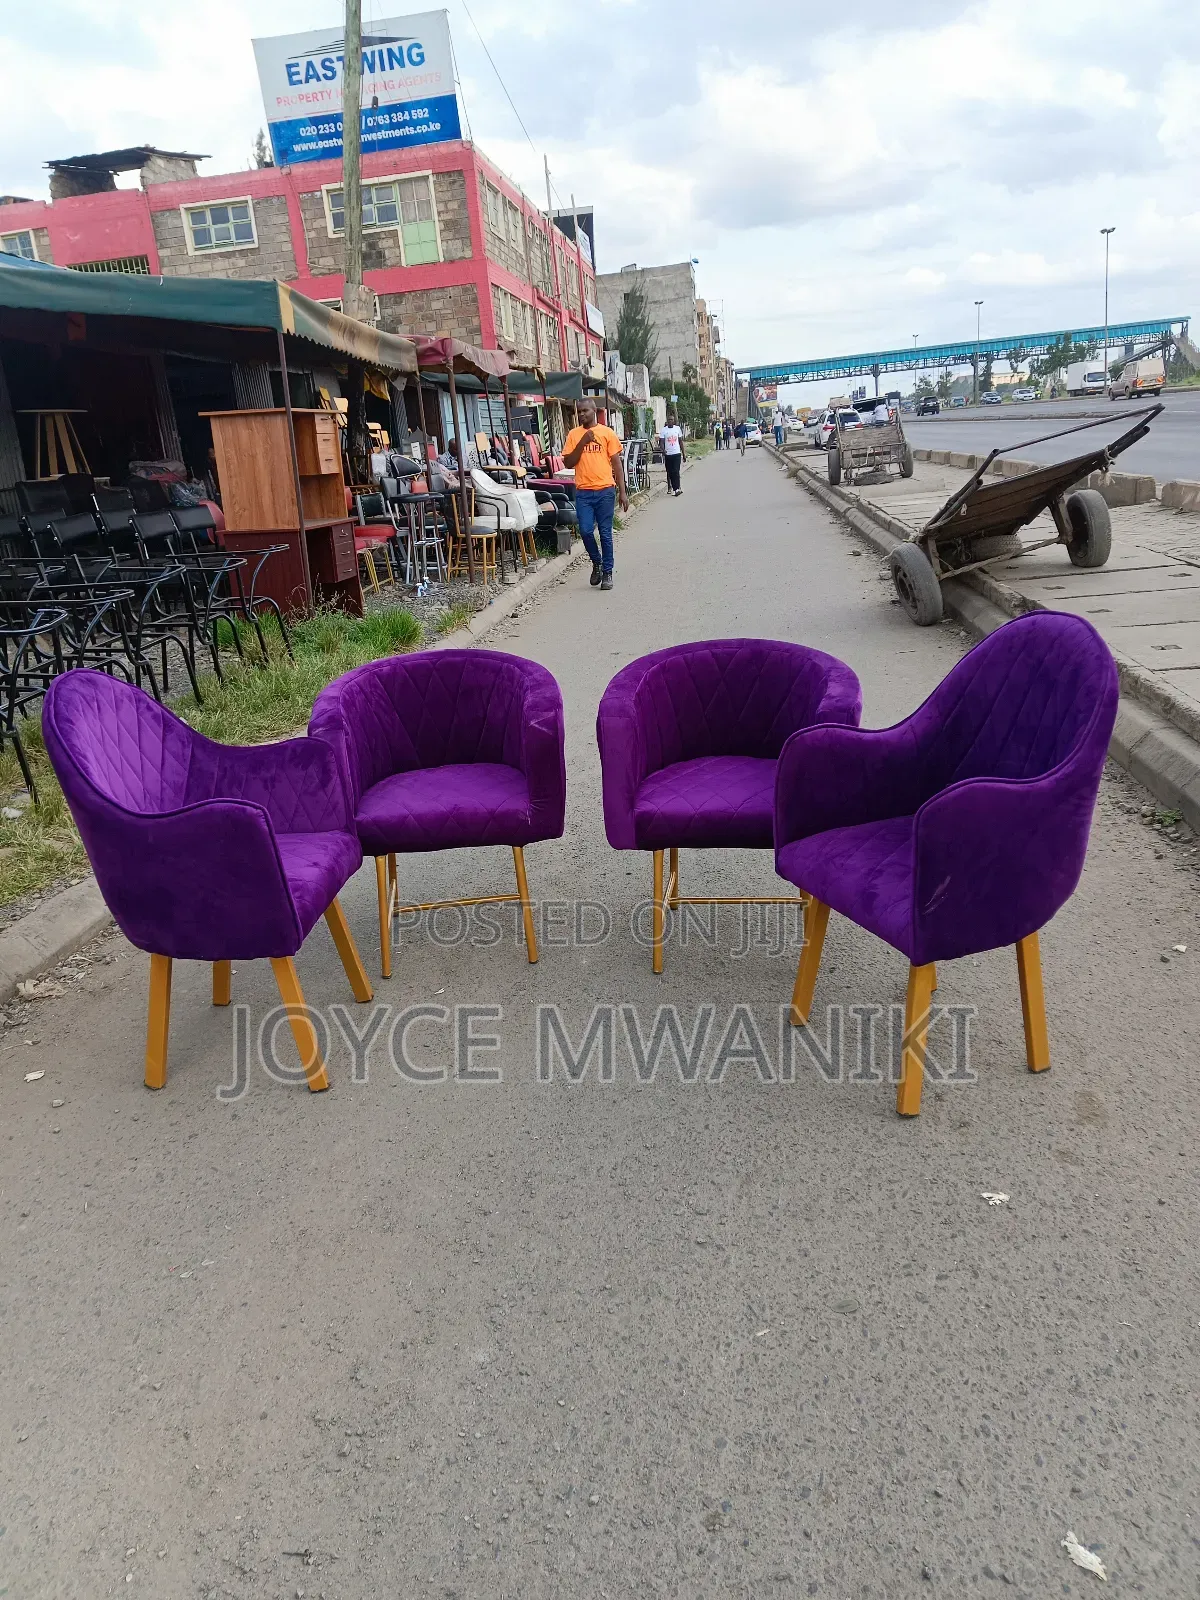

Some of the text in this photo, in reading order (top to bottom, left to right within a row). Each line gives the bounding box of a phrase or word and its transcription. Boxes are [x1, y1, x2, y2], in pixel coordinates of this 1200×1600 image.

[276, 88, 332, 107] PROPERTY
[398, 71, 441, 89] AGENTS
[299, 126, 317, 137] 020
[318, 123, 336, 134] 233
[367, 114, 390, 127] 0763
[390, 110, 411, 122] 384
[411, 107, 430, 119] 592
